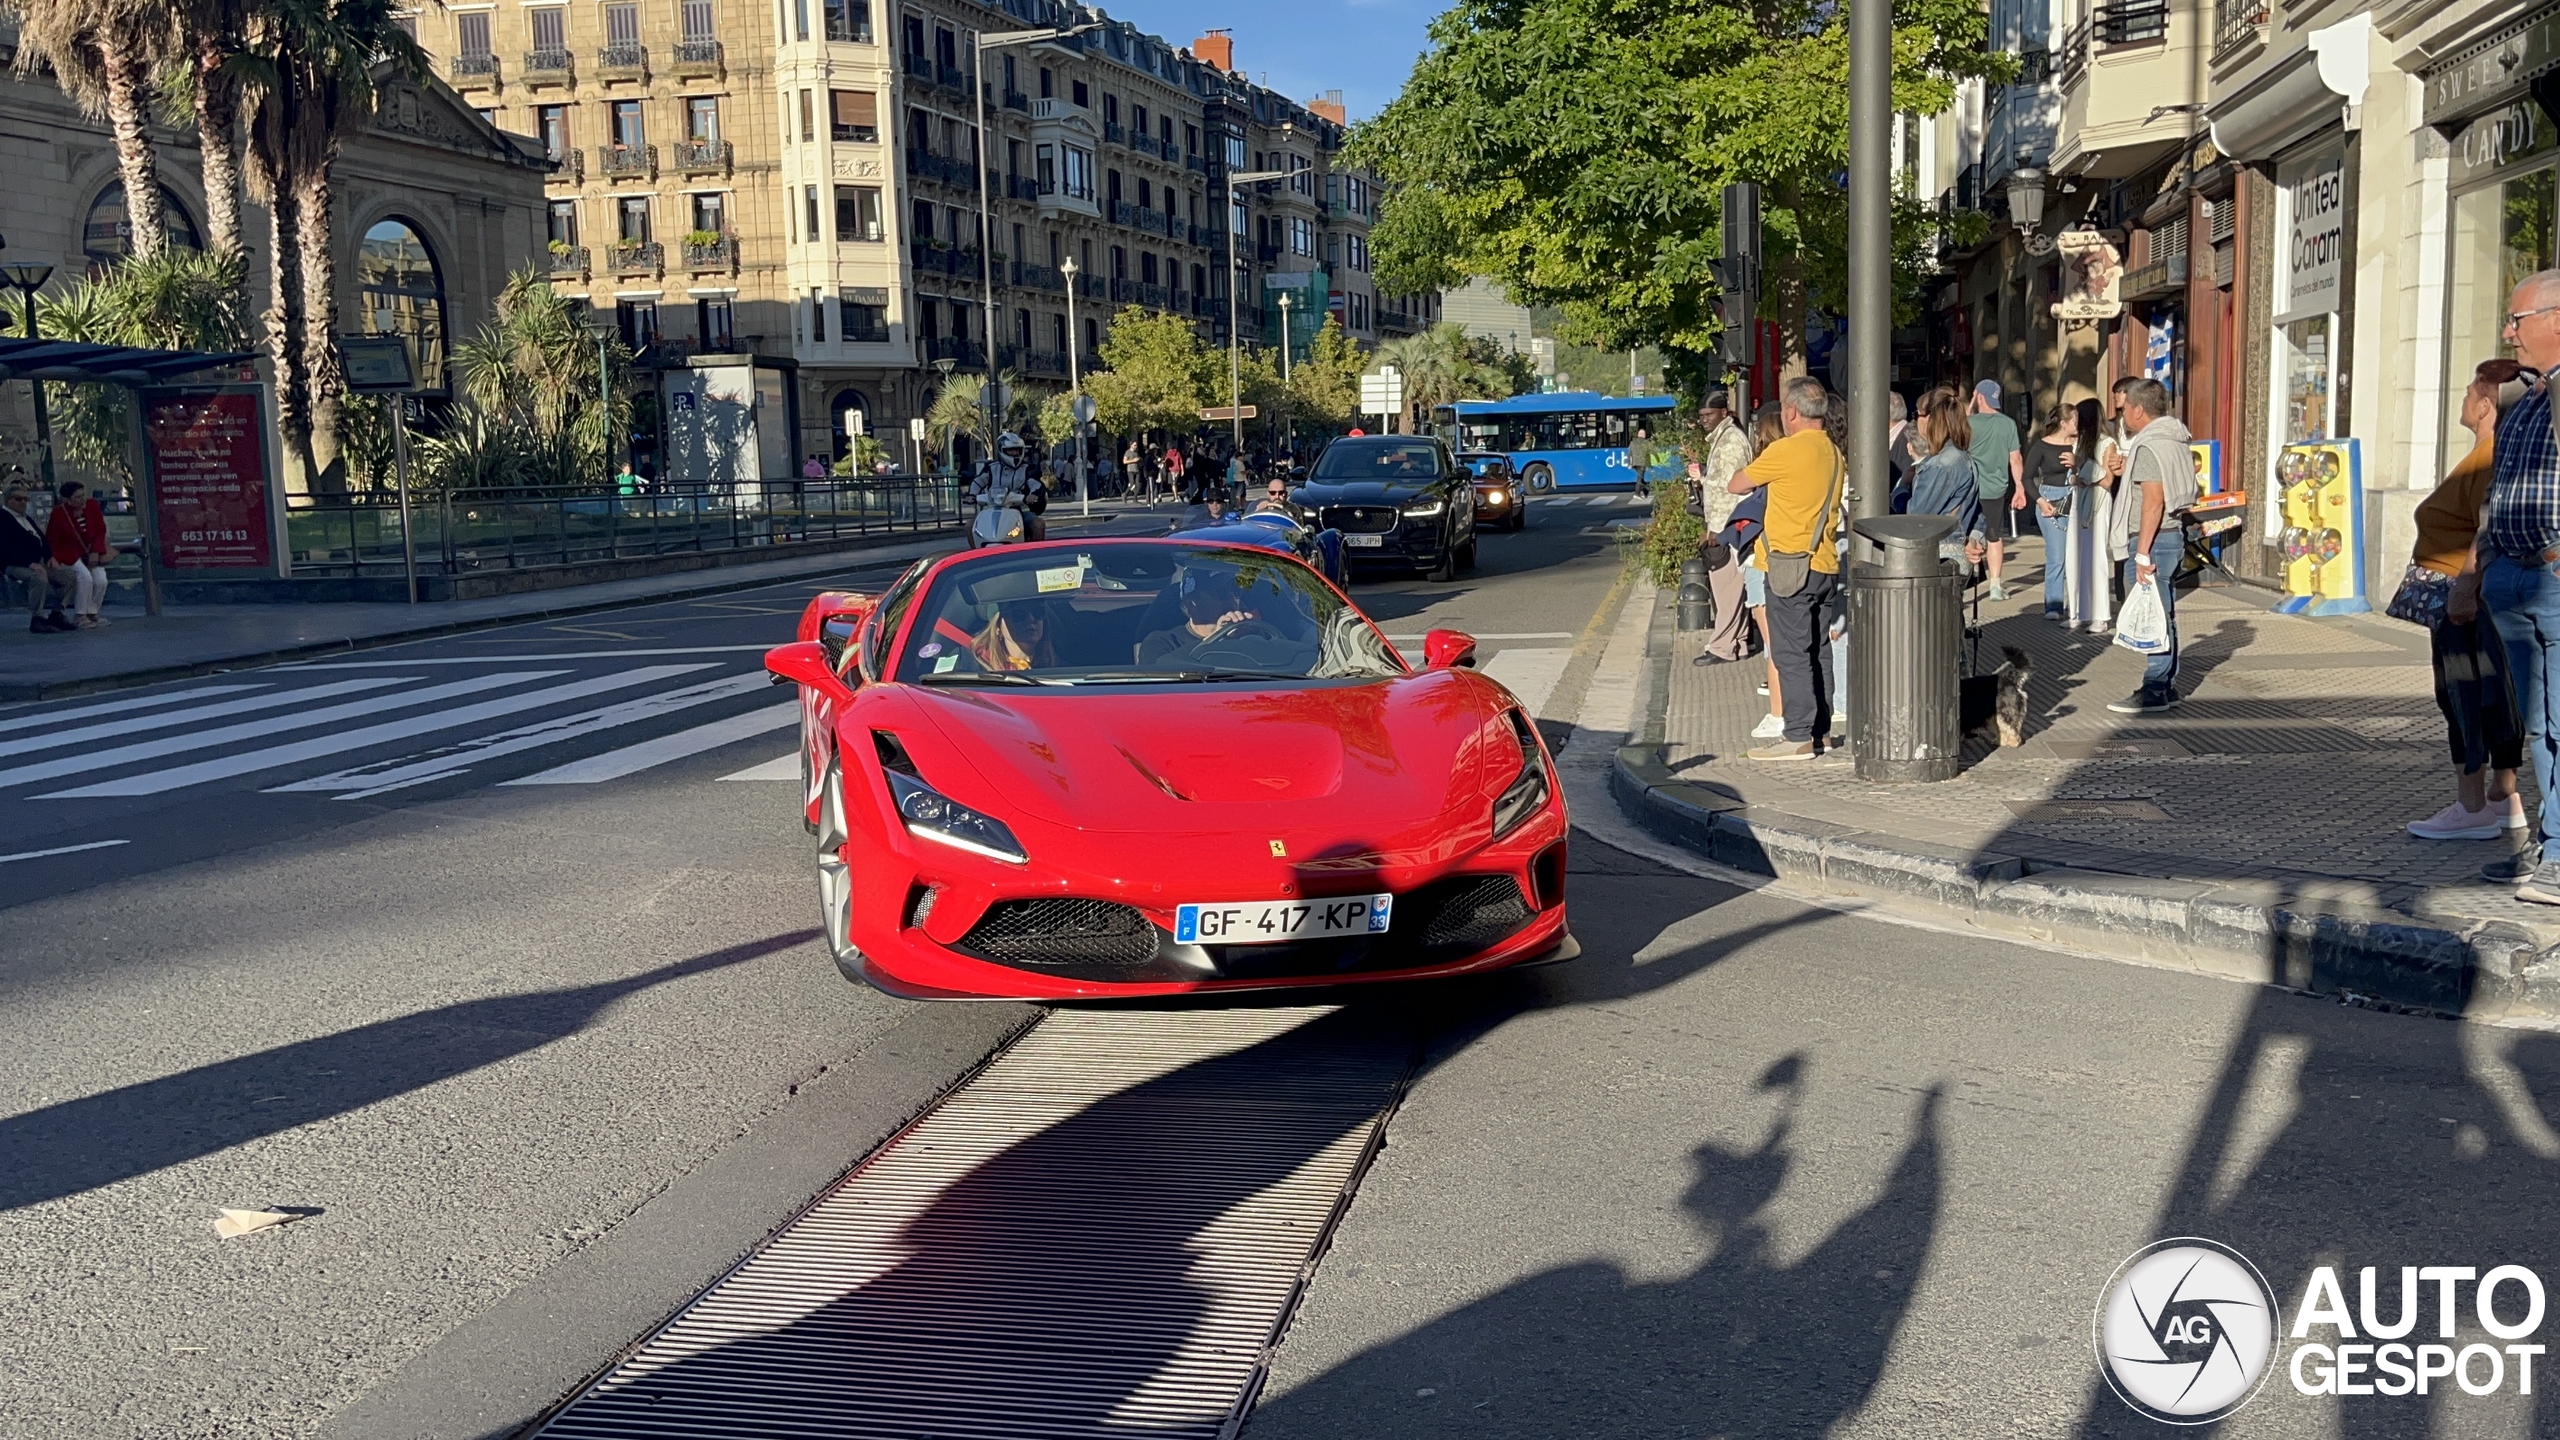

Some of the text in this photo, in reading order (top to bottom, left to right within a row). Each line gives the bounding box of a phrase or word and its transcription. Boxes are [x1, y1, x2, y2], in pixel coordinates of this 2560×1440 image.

[2463, 101, 2539, 169] CANDY
[2293, 159, 2340, 225] United
[677, 394, 688, 412] P
[222, 472, 238, 480] ven
[218, 483, 240, 492] cada
[182, 529, 248, 541] 663 17 16 13
[1365, 537, 1381, 546] JPH
[1369, 914, 1386, 929] 33
[1183, 927, 1191, 936] F
